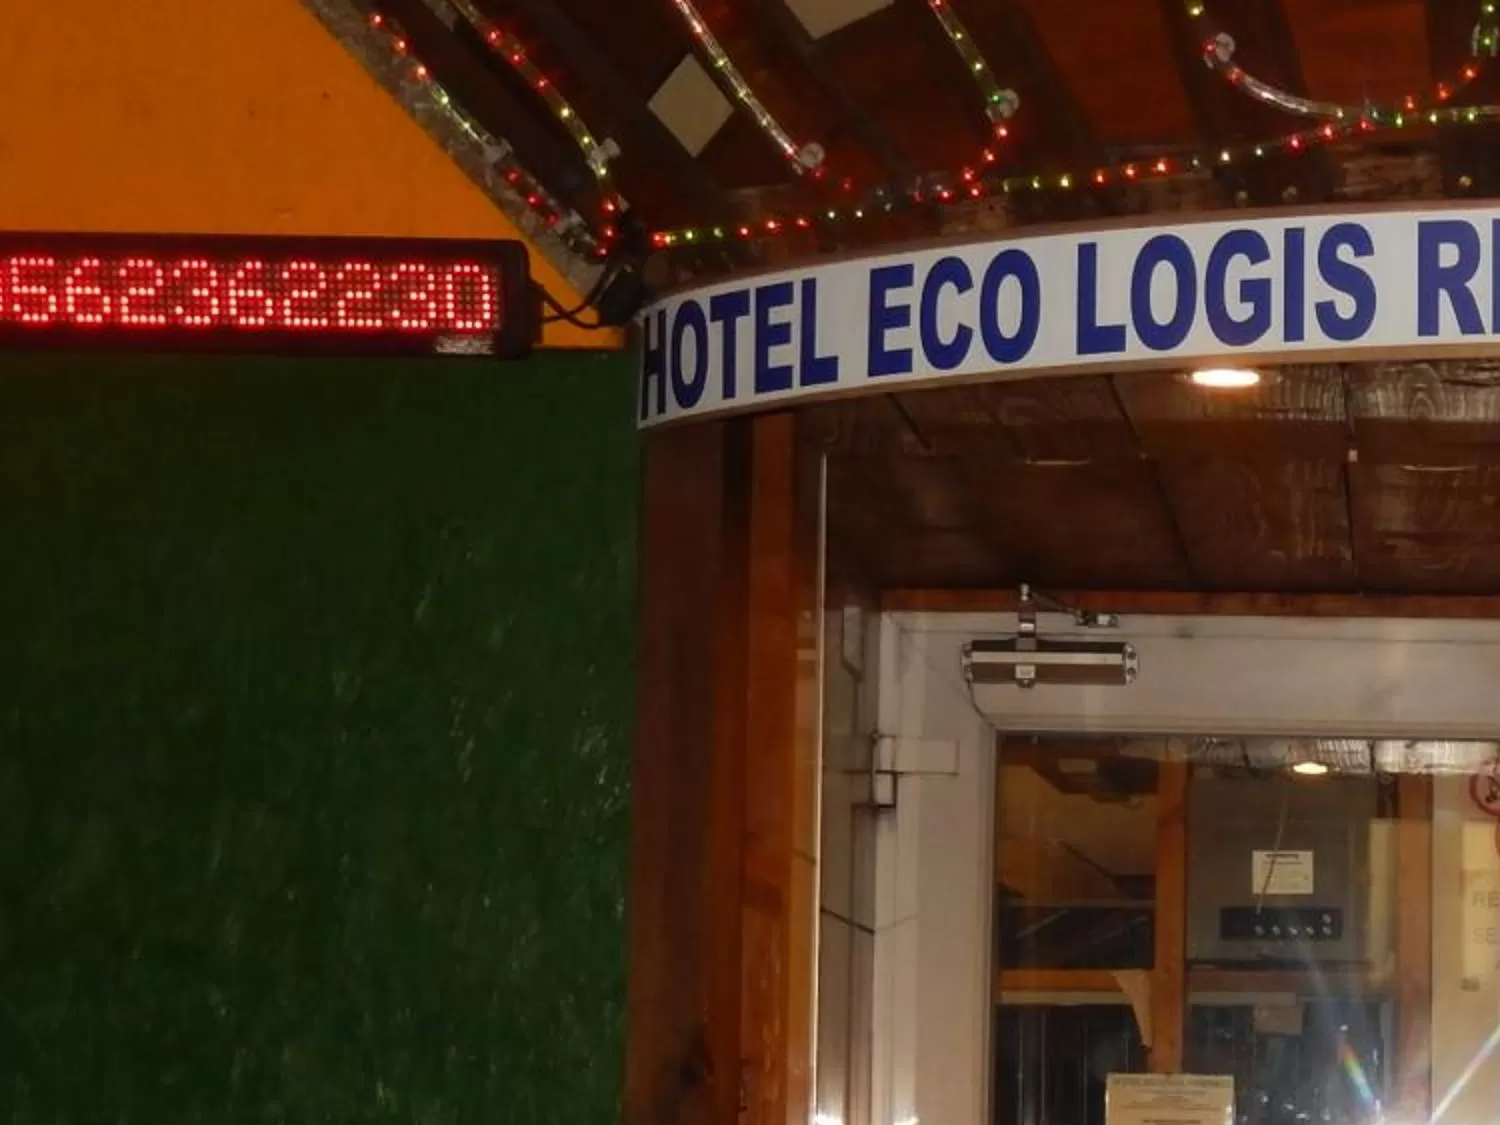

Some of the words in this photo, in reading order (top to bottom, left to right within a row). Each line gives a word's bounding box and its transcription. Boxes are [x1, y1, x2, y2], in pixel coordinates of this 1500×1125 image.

[0, 257, 491, 330] 562362230
[641, 278, 839, 420] HOTEL
[867, 248, 1041, 378] ECO
[1077, 222, 1377, 355] LOGIS
